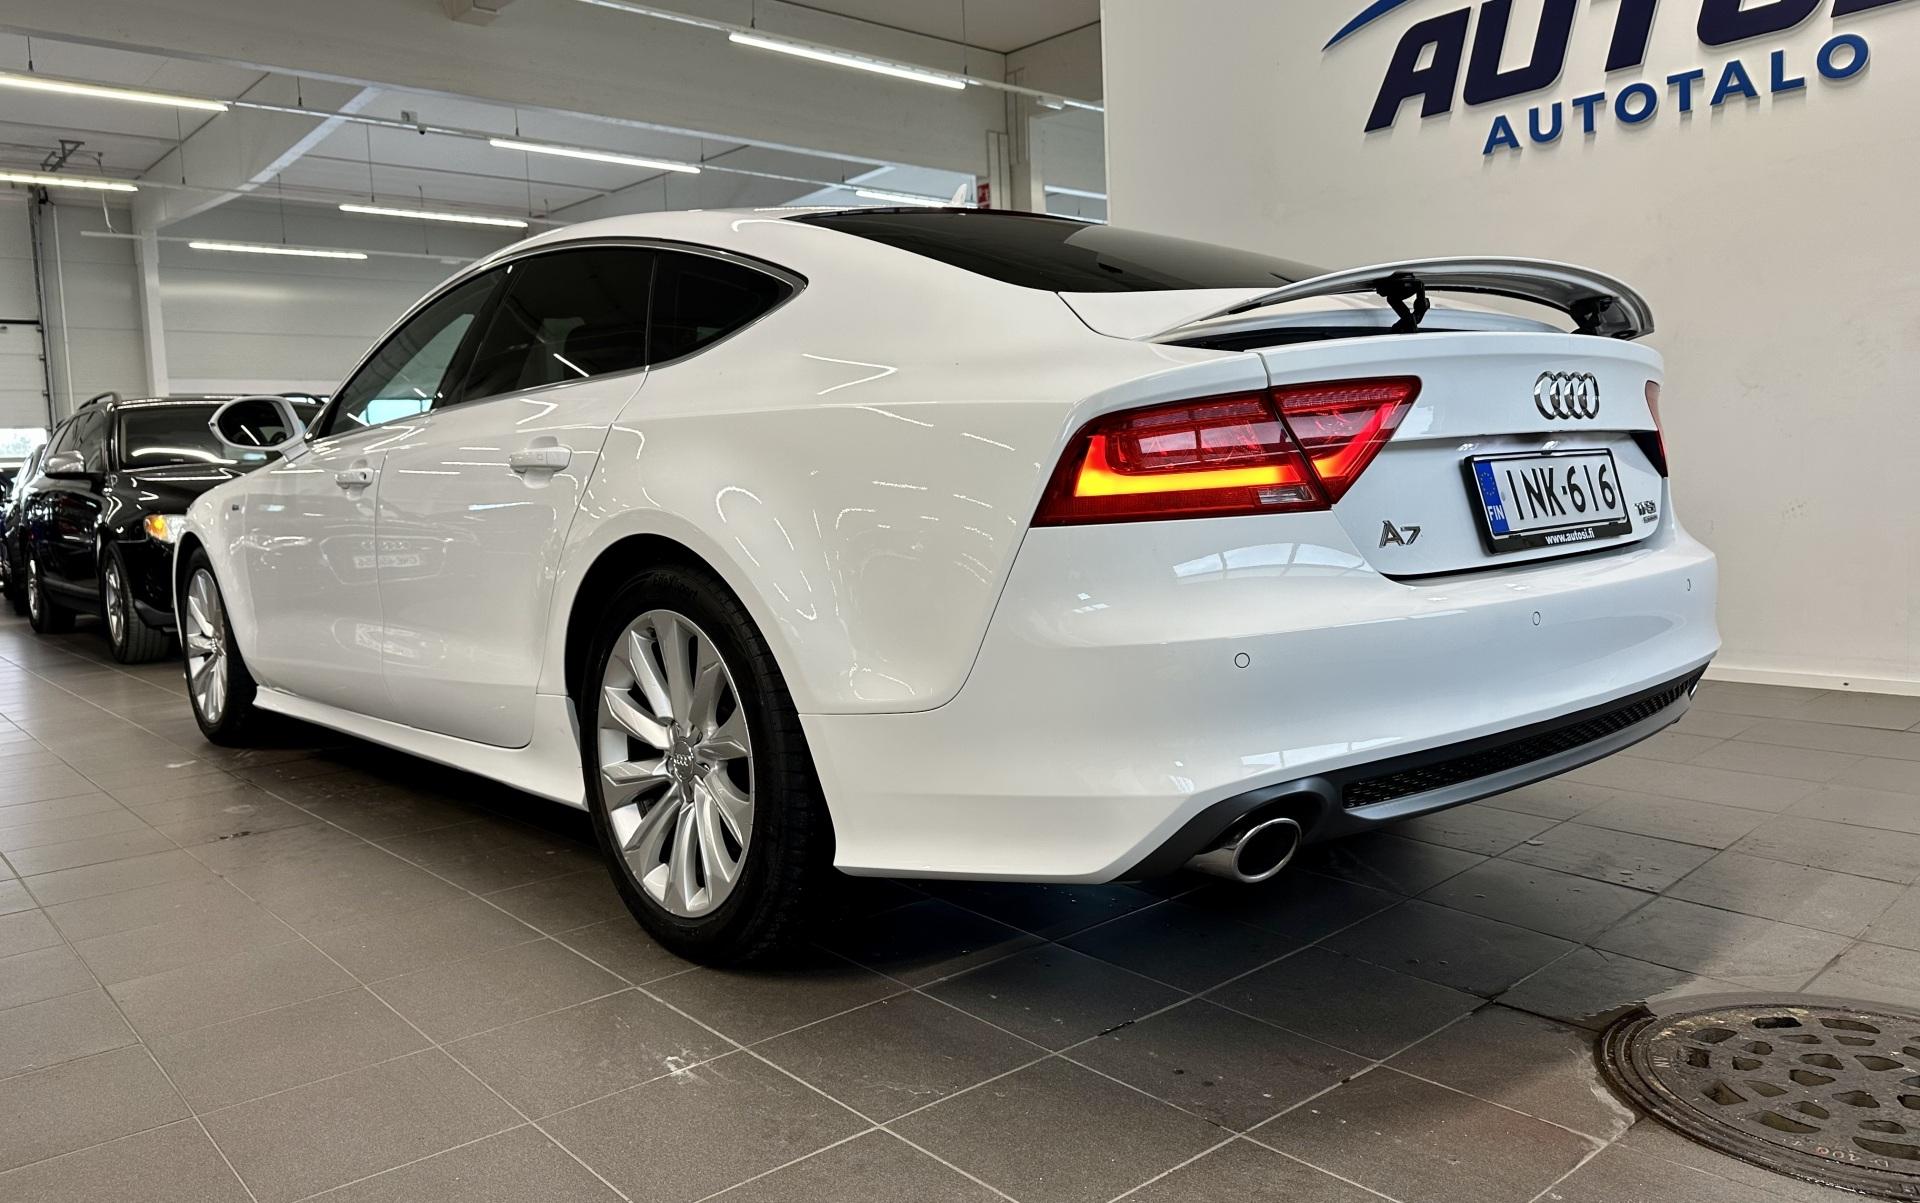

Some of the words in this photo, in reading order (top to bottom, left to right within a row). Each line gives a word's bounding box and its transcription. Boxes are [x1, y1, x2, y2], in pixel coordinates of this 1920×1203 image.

[1483, 34, 1870, 156] AUTOTALO
[1506, 463, 1616, 521] INK-616
[1486, 504, 1505, 522] FIN
[1379, 520, 1421, 548] A7
[1545, 527, 1595, 545] www.autosi.fi
